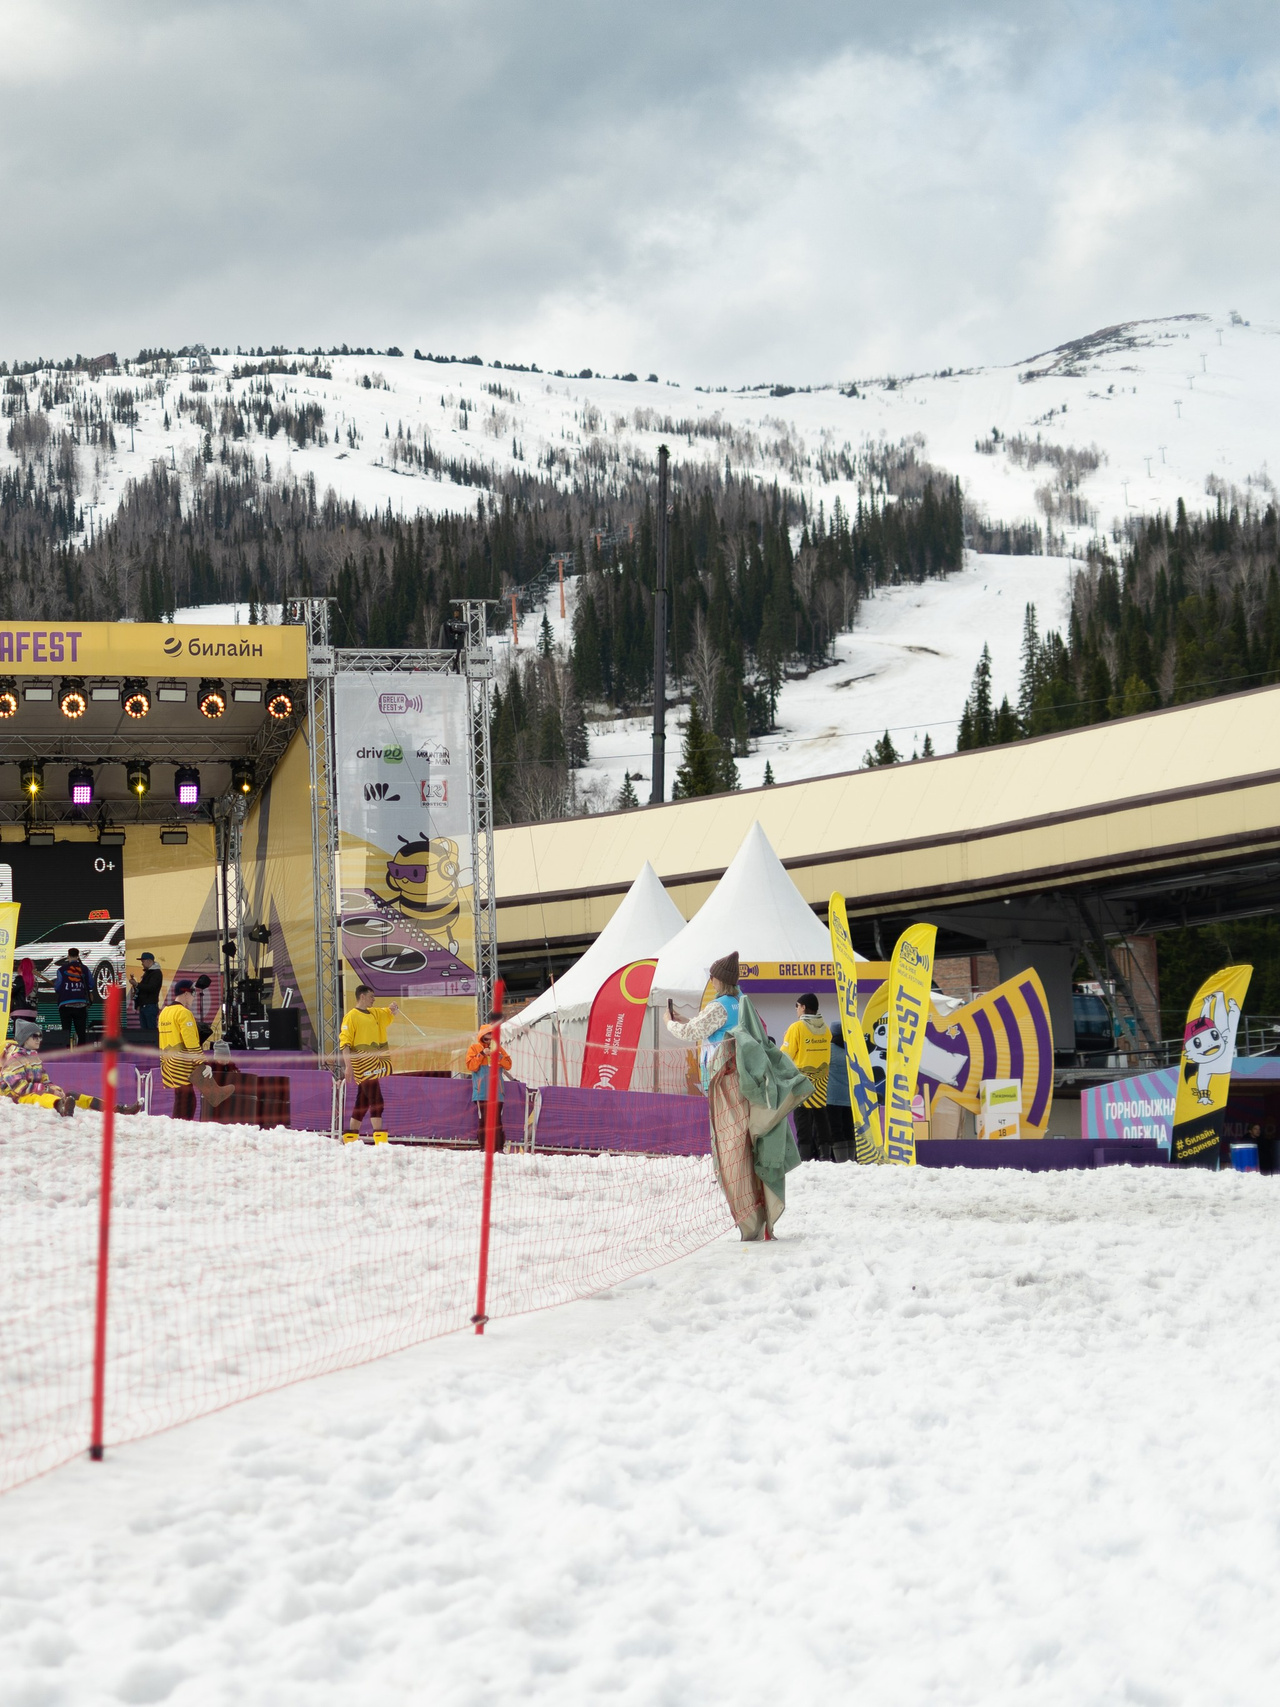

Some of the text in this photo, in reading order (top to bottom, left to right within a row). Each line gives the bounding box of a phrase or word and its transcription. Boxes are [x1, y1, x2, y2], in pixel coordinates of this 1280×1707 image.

[188, 638, 263, 657] билайн
[94, 858, 115, 873] 0+
[779, 964, 816, 976] GRELKA
[606, 1024, 614, 1037] RIDE
[611, 1013, 625, 1056] MUSIC FESTIVAL
[1105, 1098, 1176, 1120] ГОРНОЛЫЖНА
[999, 1129, 1007, 1137] 18
[1185, 1128, 1215, 1149] билайн
[1177, 1136, 1220, 1159] соединяет
